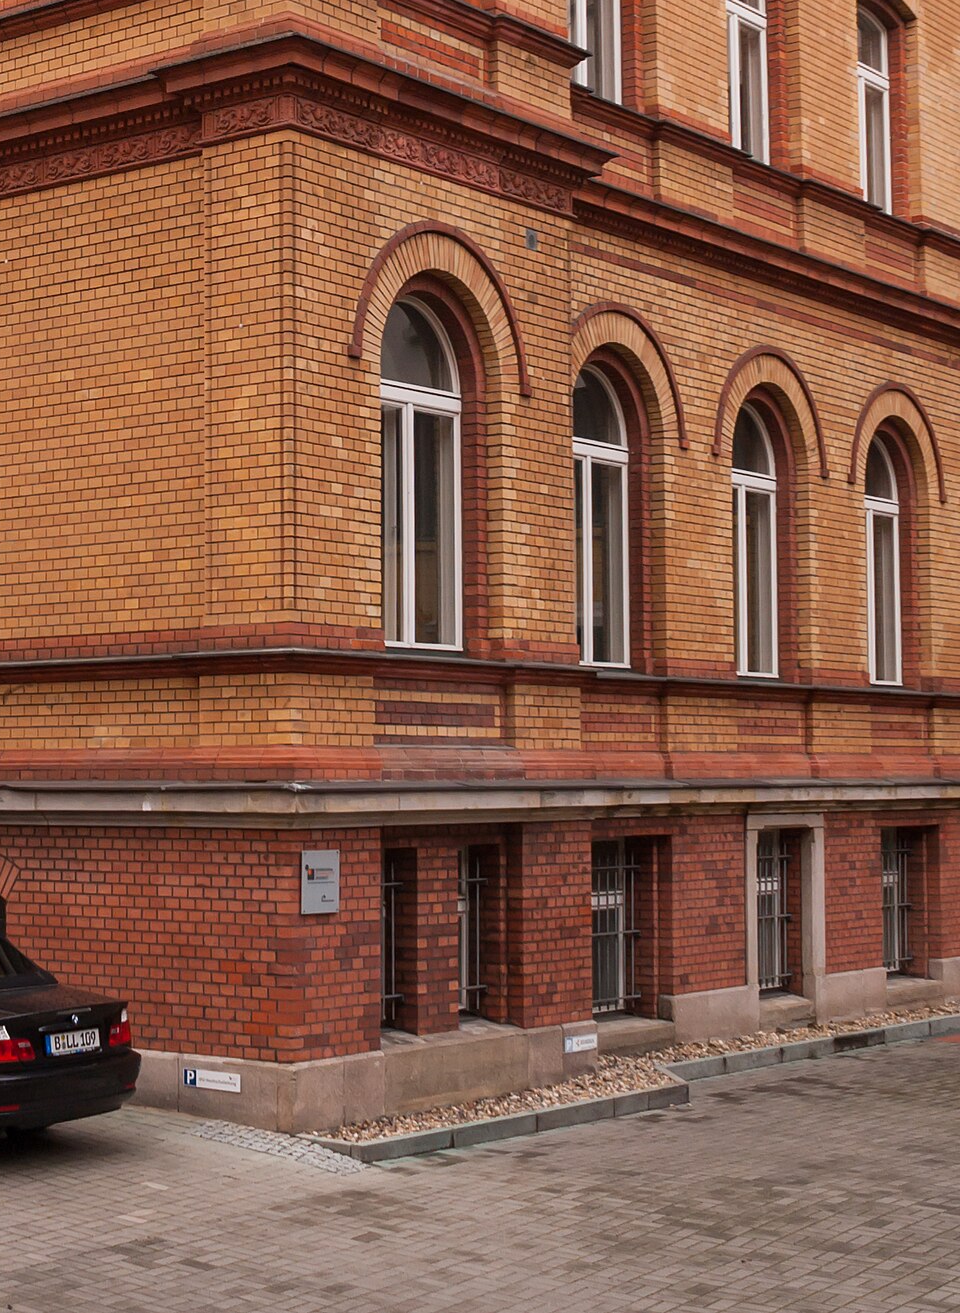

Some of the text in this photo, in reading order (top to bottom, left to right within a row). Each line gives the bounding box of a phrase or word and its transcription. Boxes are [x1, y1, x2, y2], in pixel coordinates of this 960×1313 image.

[54, 1031, 96, 1050] B LL 109
[187, 1070, 194, 1085] P
